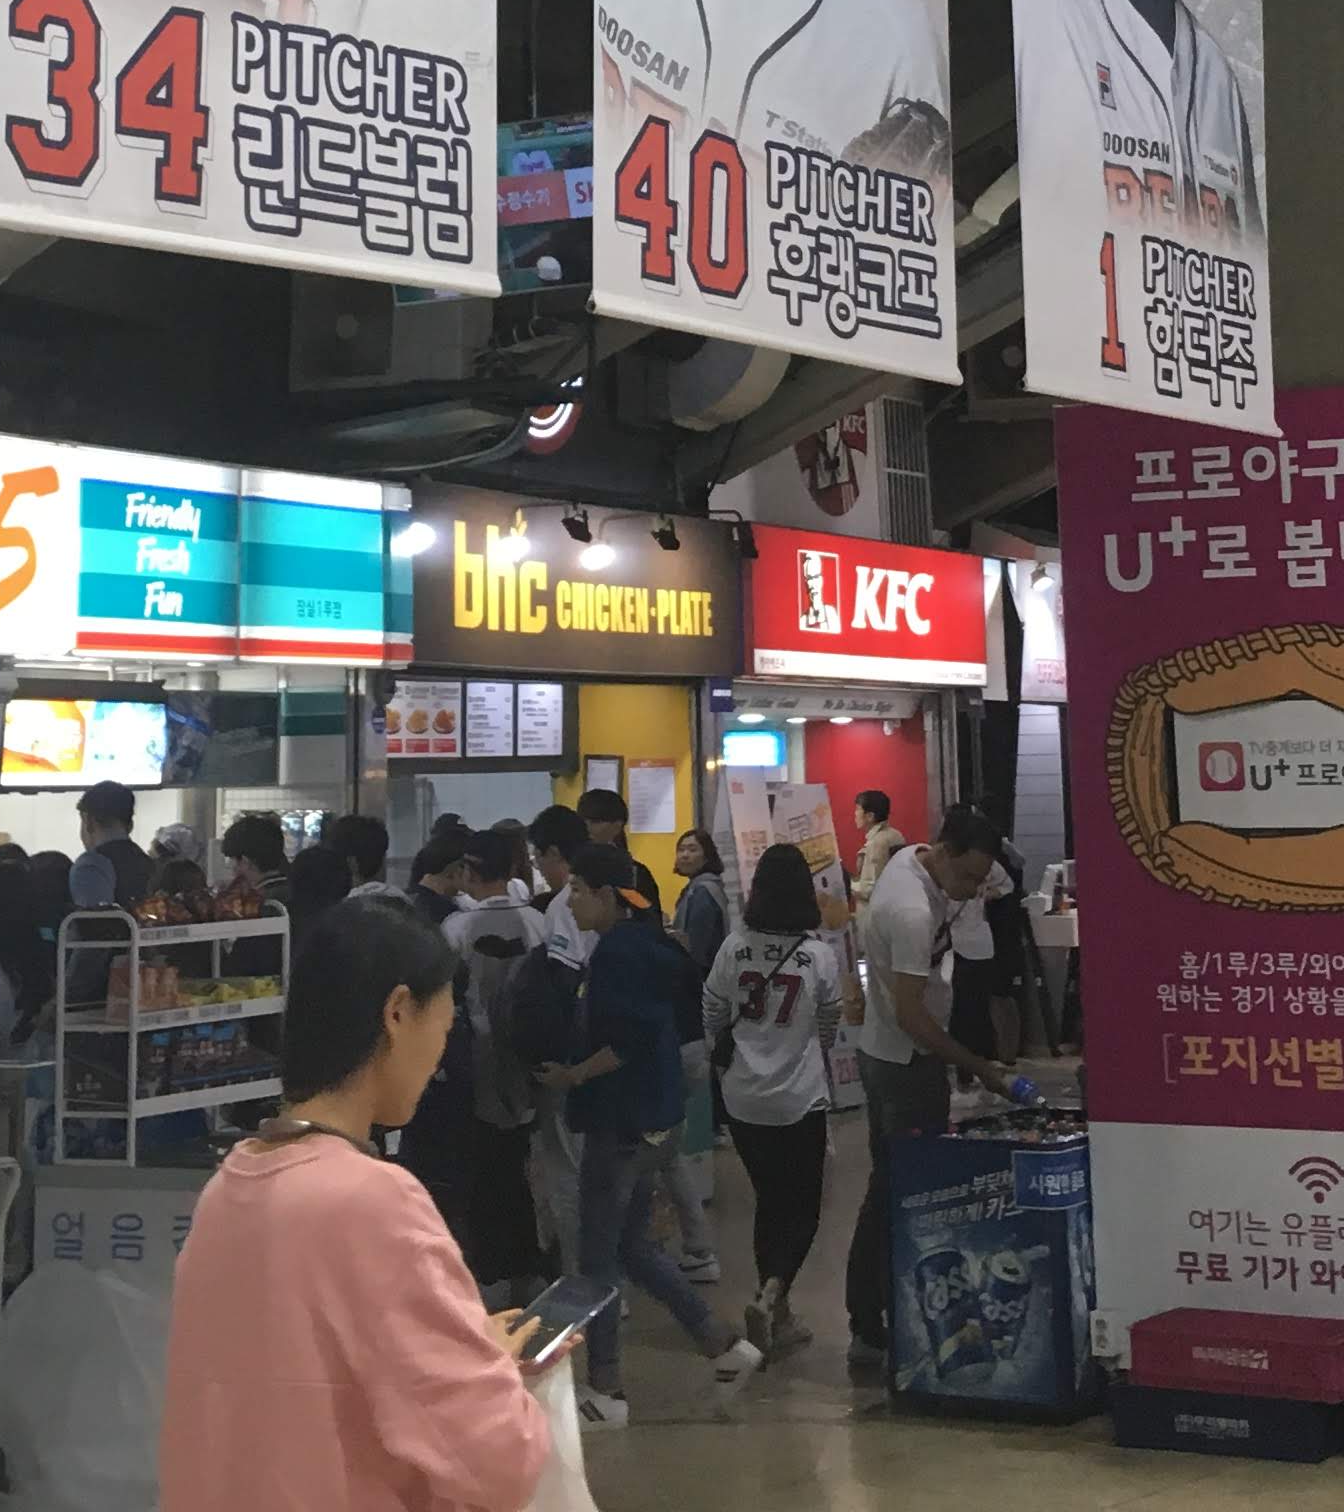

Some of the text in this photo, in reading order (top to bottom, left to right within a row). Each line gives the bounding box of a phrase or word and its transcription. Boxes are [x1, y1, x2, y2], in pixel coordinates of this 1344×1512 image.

[230, 11, 470, 136] PITCHER
[598, 3, 691, 92] DOOSAN
[232, 103, 473, 265] 린드블럼
[614, 114, 749, 301] 40
[763, 141, 936, 246] PITCHER
[767, 215, 942, 340] 후랭코프
[1099, 231, 1126, 373] 1
[1140, 234, 1256, 320] PITCHER
[1143, 301, 1259, 408] 함덕주
[124, 491, 202, 544] Friendly
[135, 536, 191, 576] Fresh
[143, 580, 184, 618] Fun
[453, 518, 548, 635] bhc
[851, 565, 935, 636] KFC
[1319, 740, 1332, 754] 더
[738, 970, 804, 1025] 37
[1156, 984, 1223, 1013] 원하는
[1231, 985, 1275, 1014] 경기
[1188, 1209, 1271, 1247] 여기는
[1175, 1250, 1233, 1285] 무료
[1242, 1255, 1300, 1293] 기가
